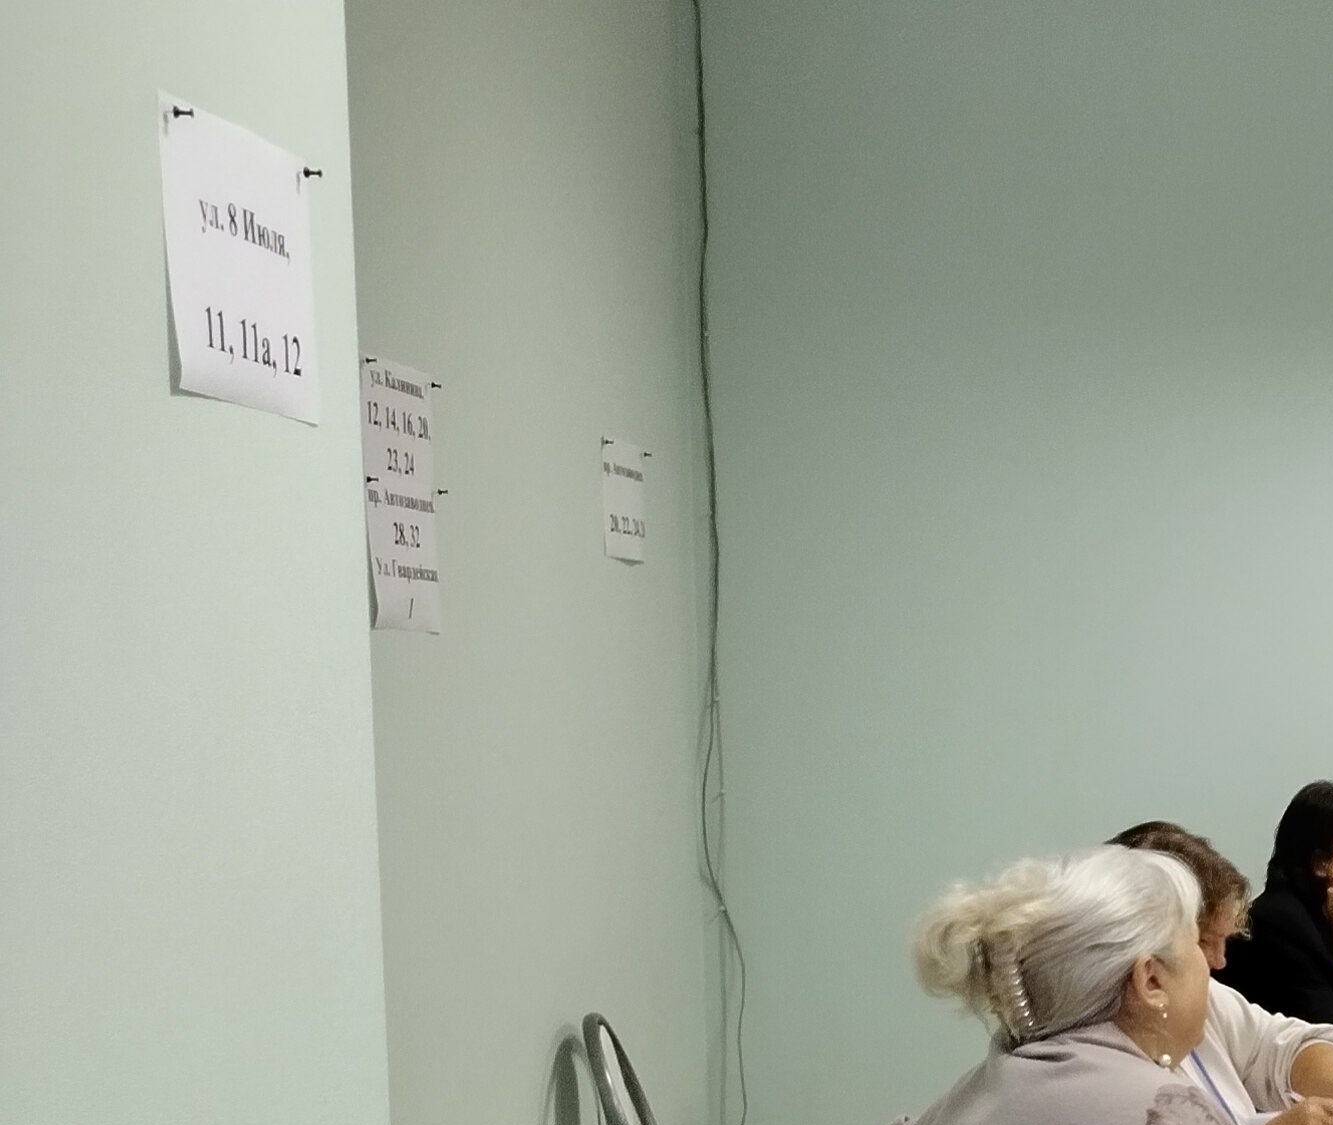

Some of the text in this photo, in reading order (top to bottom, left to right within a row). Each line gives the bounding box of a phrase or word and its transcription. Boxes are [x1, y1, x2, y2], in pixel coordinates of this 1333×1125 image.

[199, 199, 291, 265] ул. 8 Июля,
[205, 306, 302, 378] 11, 11а, 12
[368, 400, 382, 431] 12,
[386, 406, 400, 436] 14,
[402, 411, 416, 439] 16,
[387, 447, 415, 477] 23, 24
